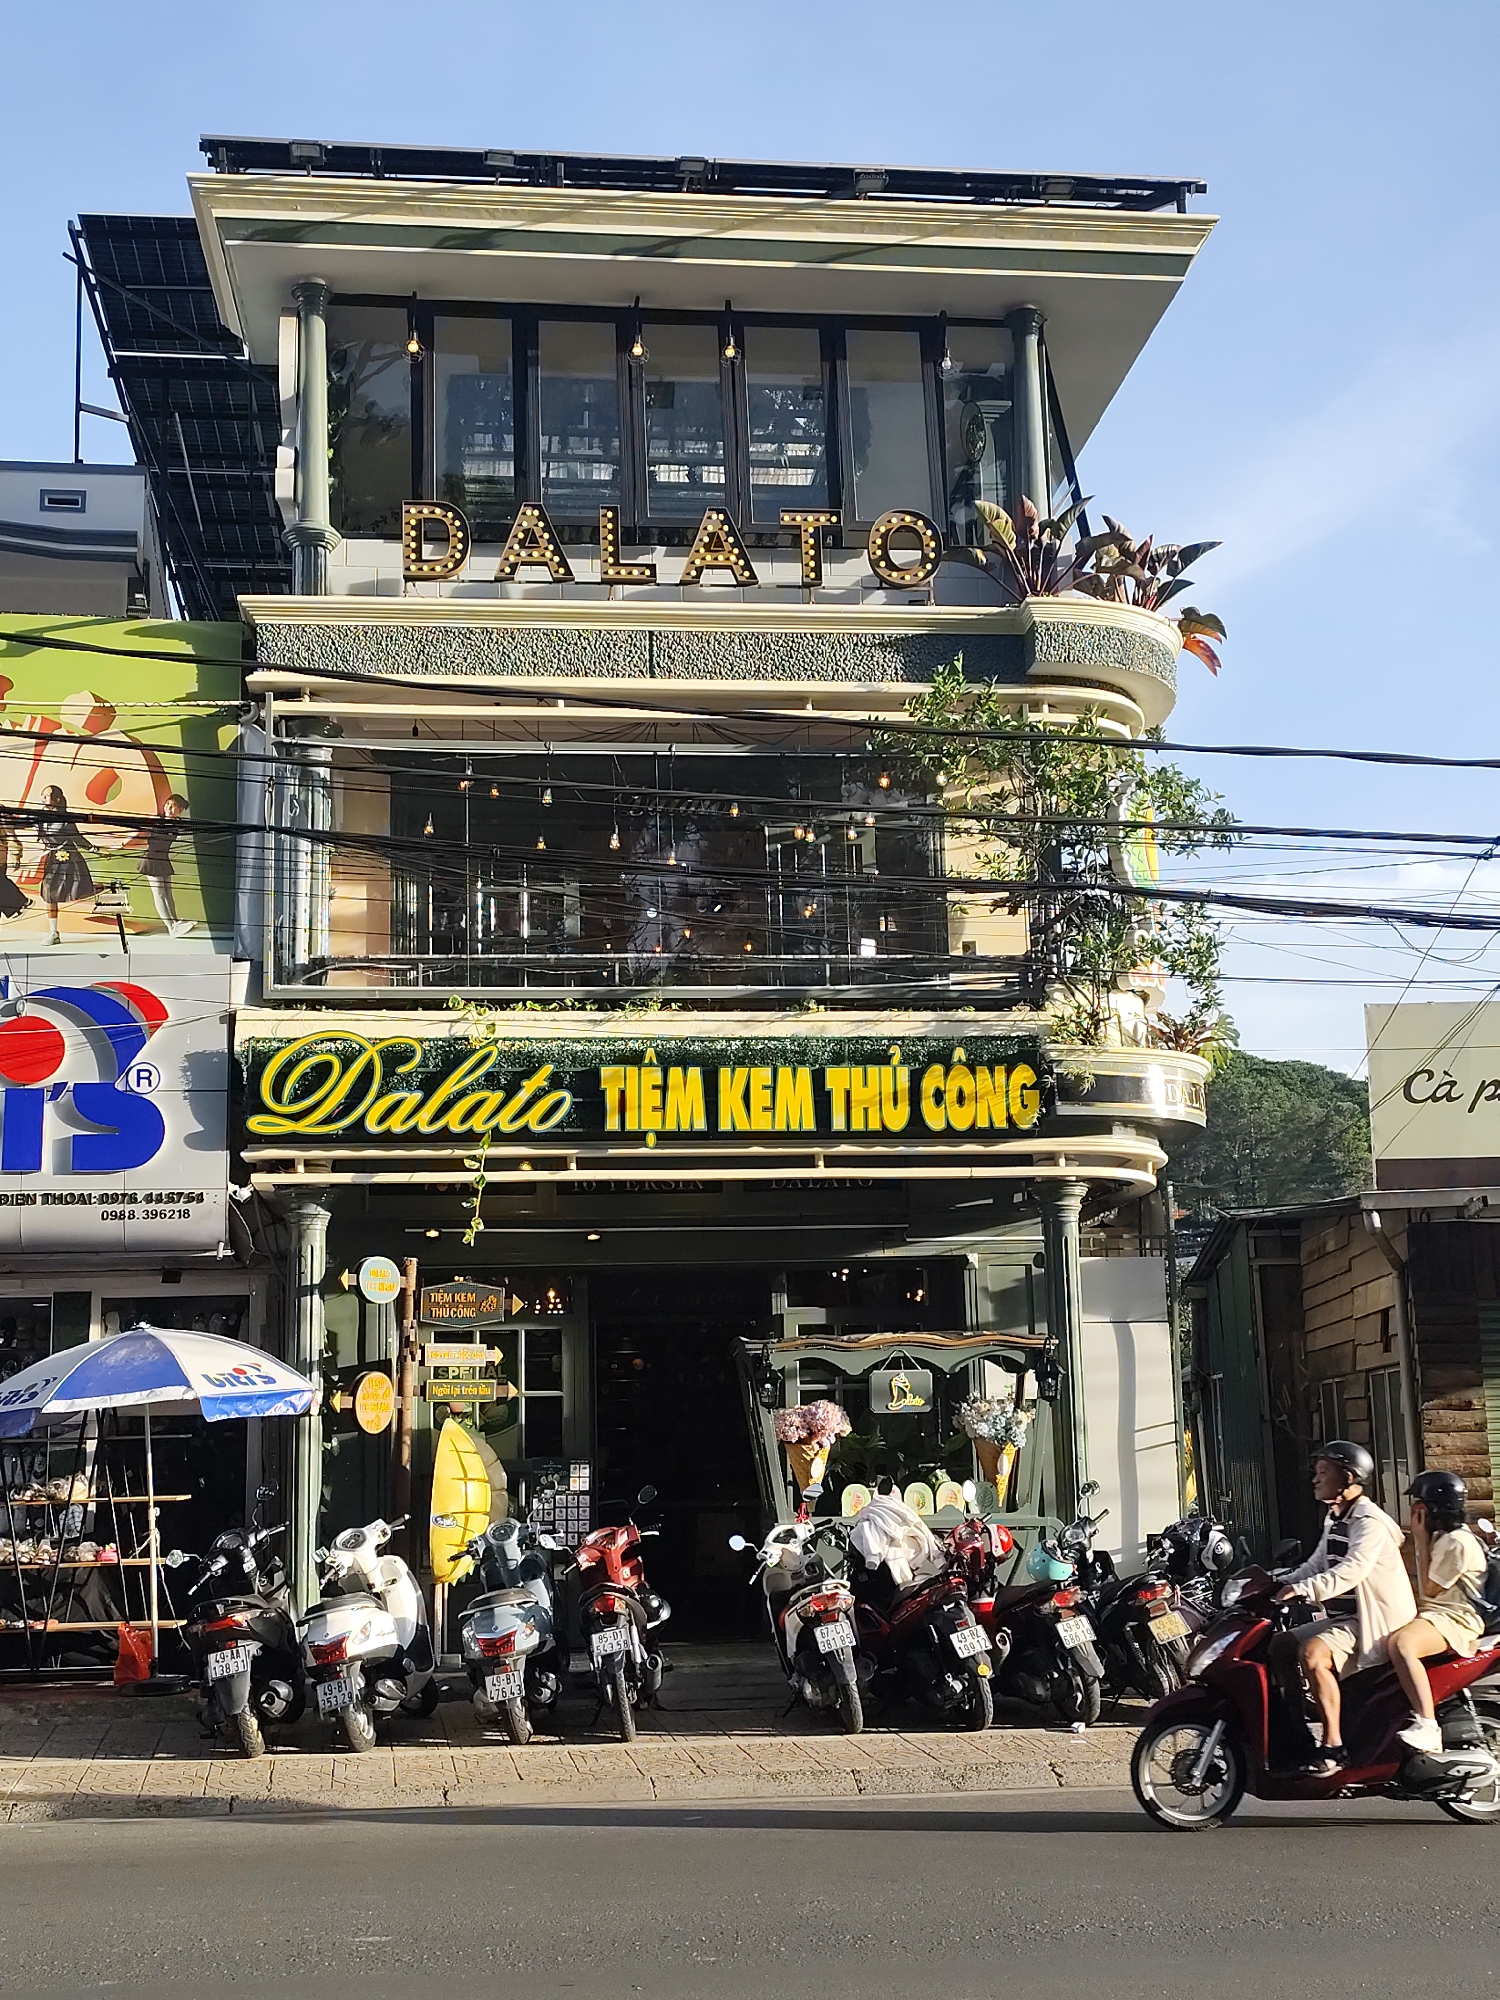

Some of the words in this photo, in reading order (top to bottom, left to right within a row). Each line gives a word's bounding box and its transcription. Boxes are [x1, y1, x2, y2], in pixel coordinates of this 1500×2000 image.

[402, 500, 944, 588] DALATO
[246, 1030, 575, 1135] Dalato
[600, 1047, 708, 1148] TIỆM
[717, 1064, 817, 1132] KEM
[826, 1044, 910, 1132] THỦ
[920, 1046, 1041, 1132] CÔNG
[1402, 1067, 1465, 1105] Cà
[101, 1208, 191, 1221] 0988.396218
[454, 1292, 477, 1303] KEM
[819, 1623, 846, 1639] 67-C1
[215, 1648, 241, 1664] 49-AA
[212, 1659, 246, 1678] 138.31
[323, 1680, 348, 1697] 49-B1
[492, 1672, 517, 1688] 49-B1
[320, 1691, 353, 1710] 353.29
